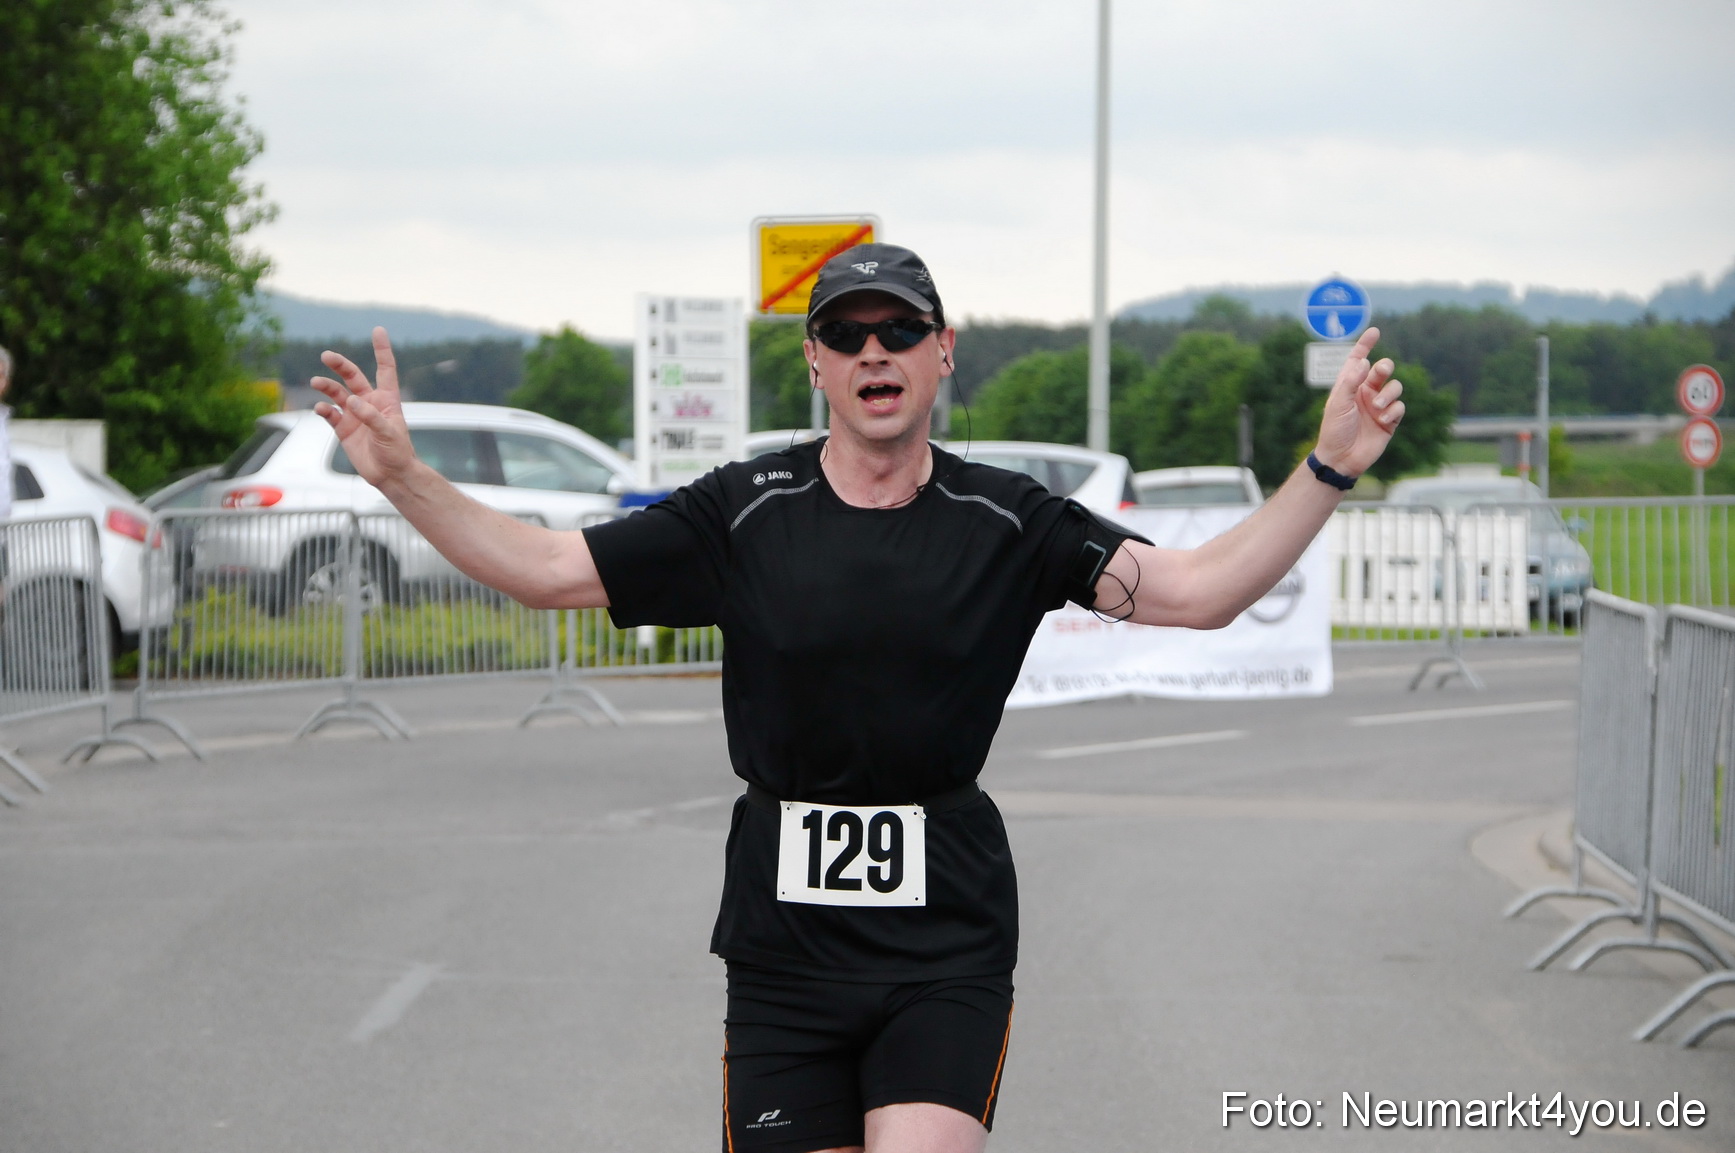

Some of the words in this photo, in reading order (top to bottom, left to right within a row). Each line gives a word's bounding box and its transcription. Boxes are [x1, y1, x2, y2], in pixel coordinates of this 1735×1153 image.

[767, 471, 793, 480] JAKO
[802, 809, 904, 894] 129
[764, 1120, 792, 1128] TOUCH
